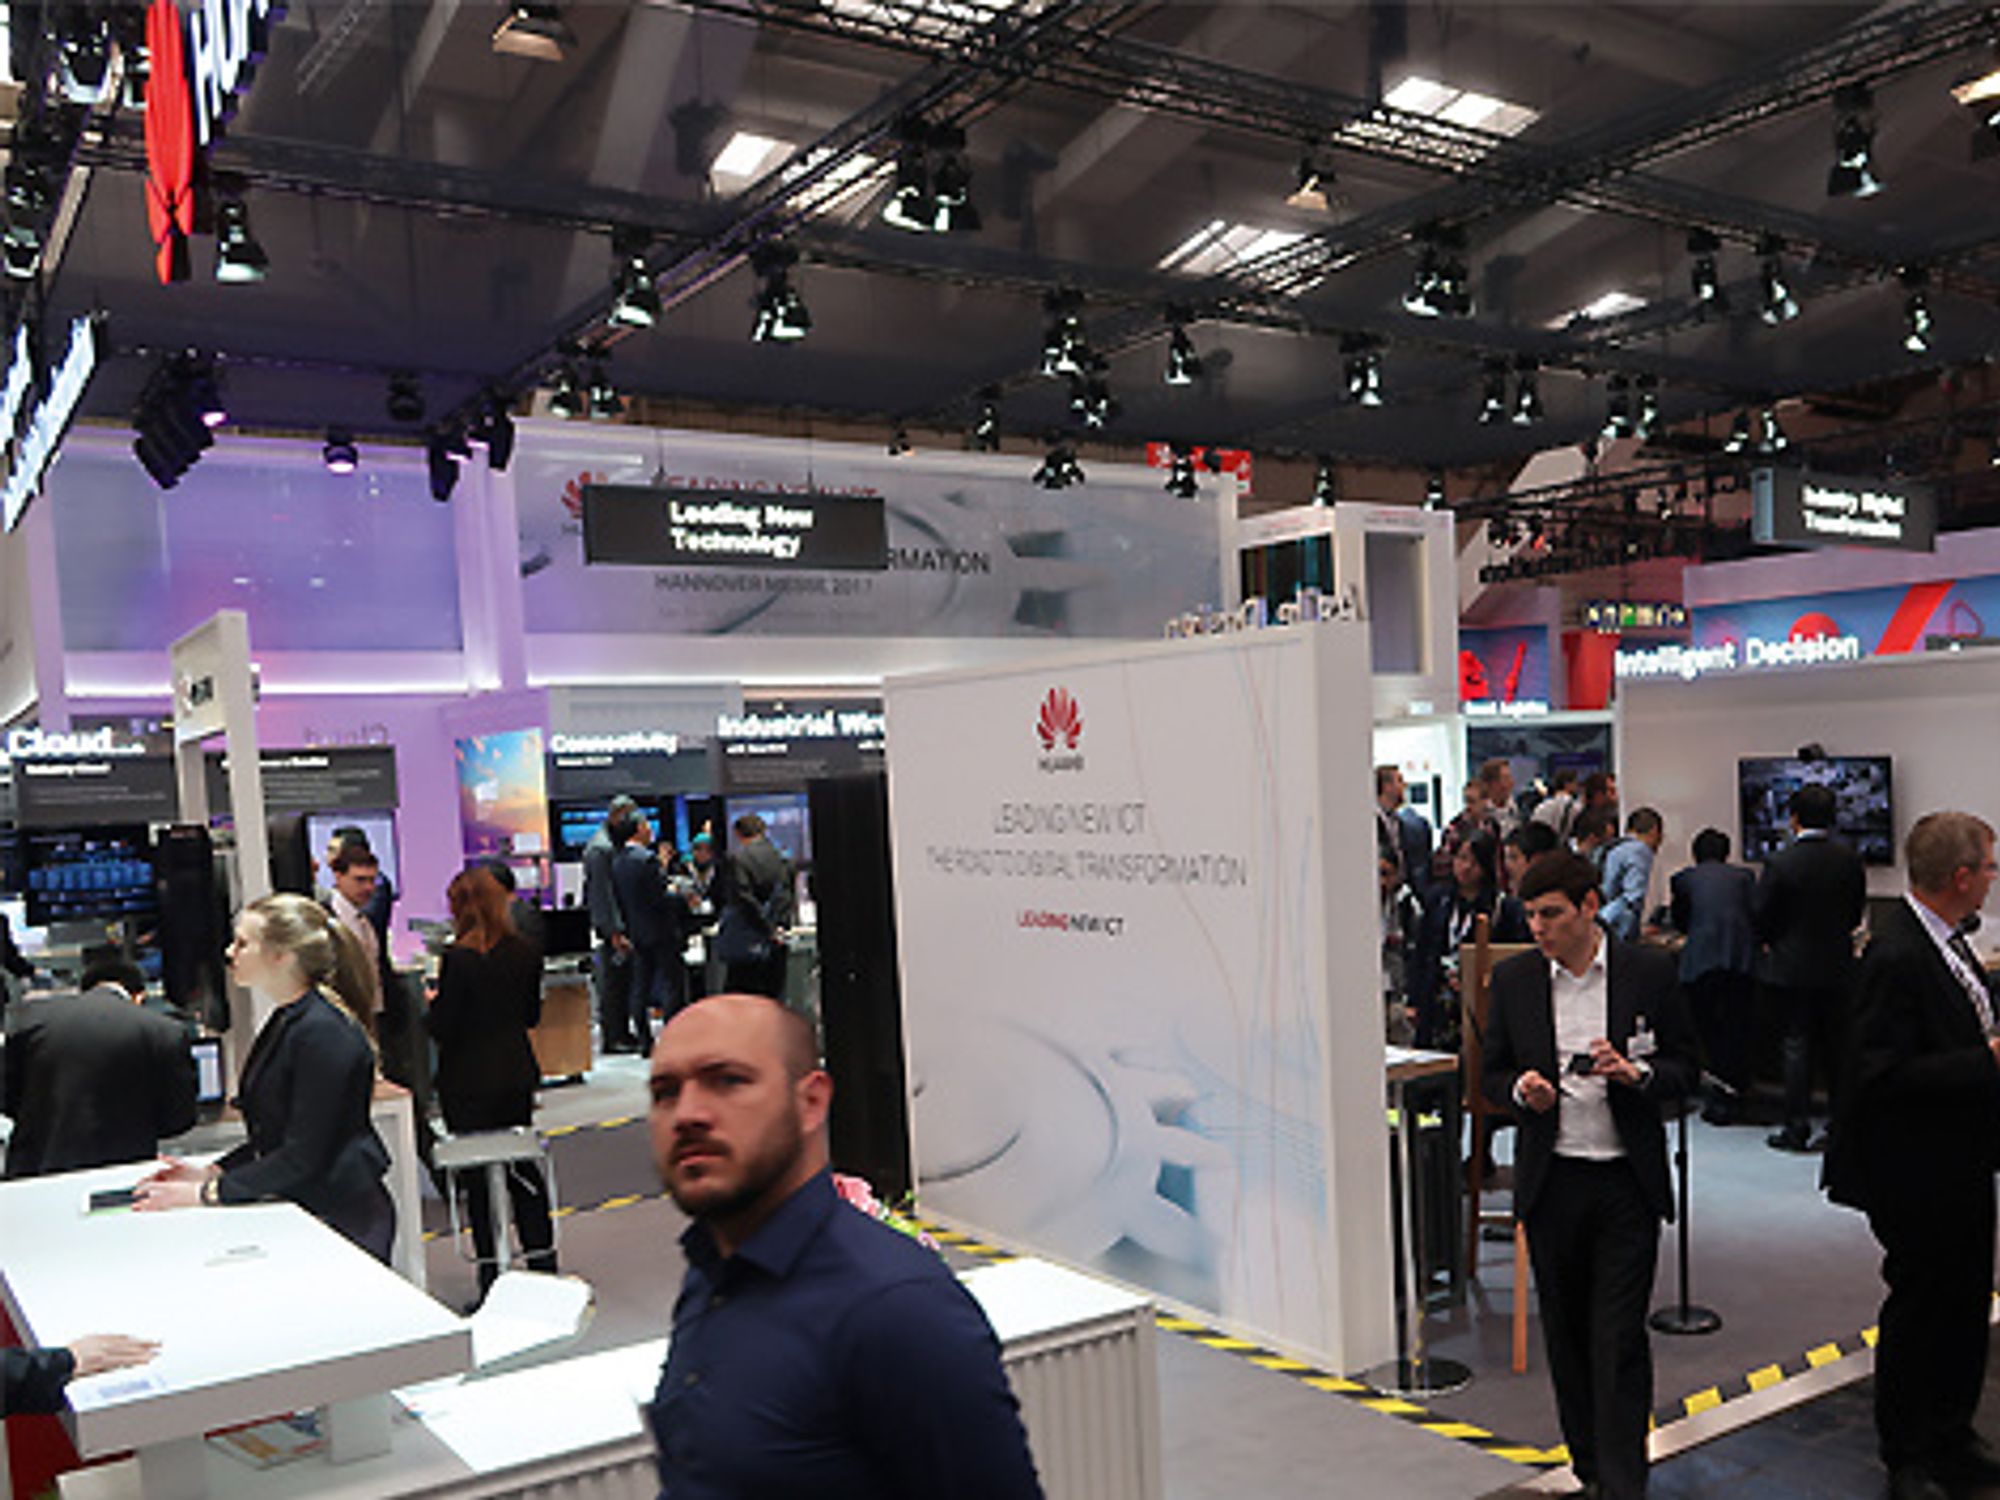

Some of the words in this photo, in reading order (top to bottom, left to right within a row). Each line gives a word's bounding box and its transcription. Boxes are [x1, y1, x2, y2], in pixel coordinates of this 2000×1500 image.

[669, 502, 761, 527] Leading
[764, 503, 814, 527] New
[670, 528, 801, 557] Technology
[1614, 643, 1735, 681] Intelligent
[1746, 632, 1859, 667] Decision
[717, 708, 835, 738] Industrial
[8, 727, 112, 757] Cloud
[550, 730, 678, 755] Connectivity
[994, 803, 1067, 834] LEADING
[1076, 849, 1247, 887] TRANSFORMATION
